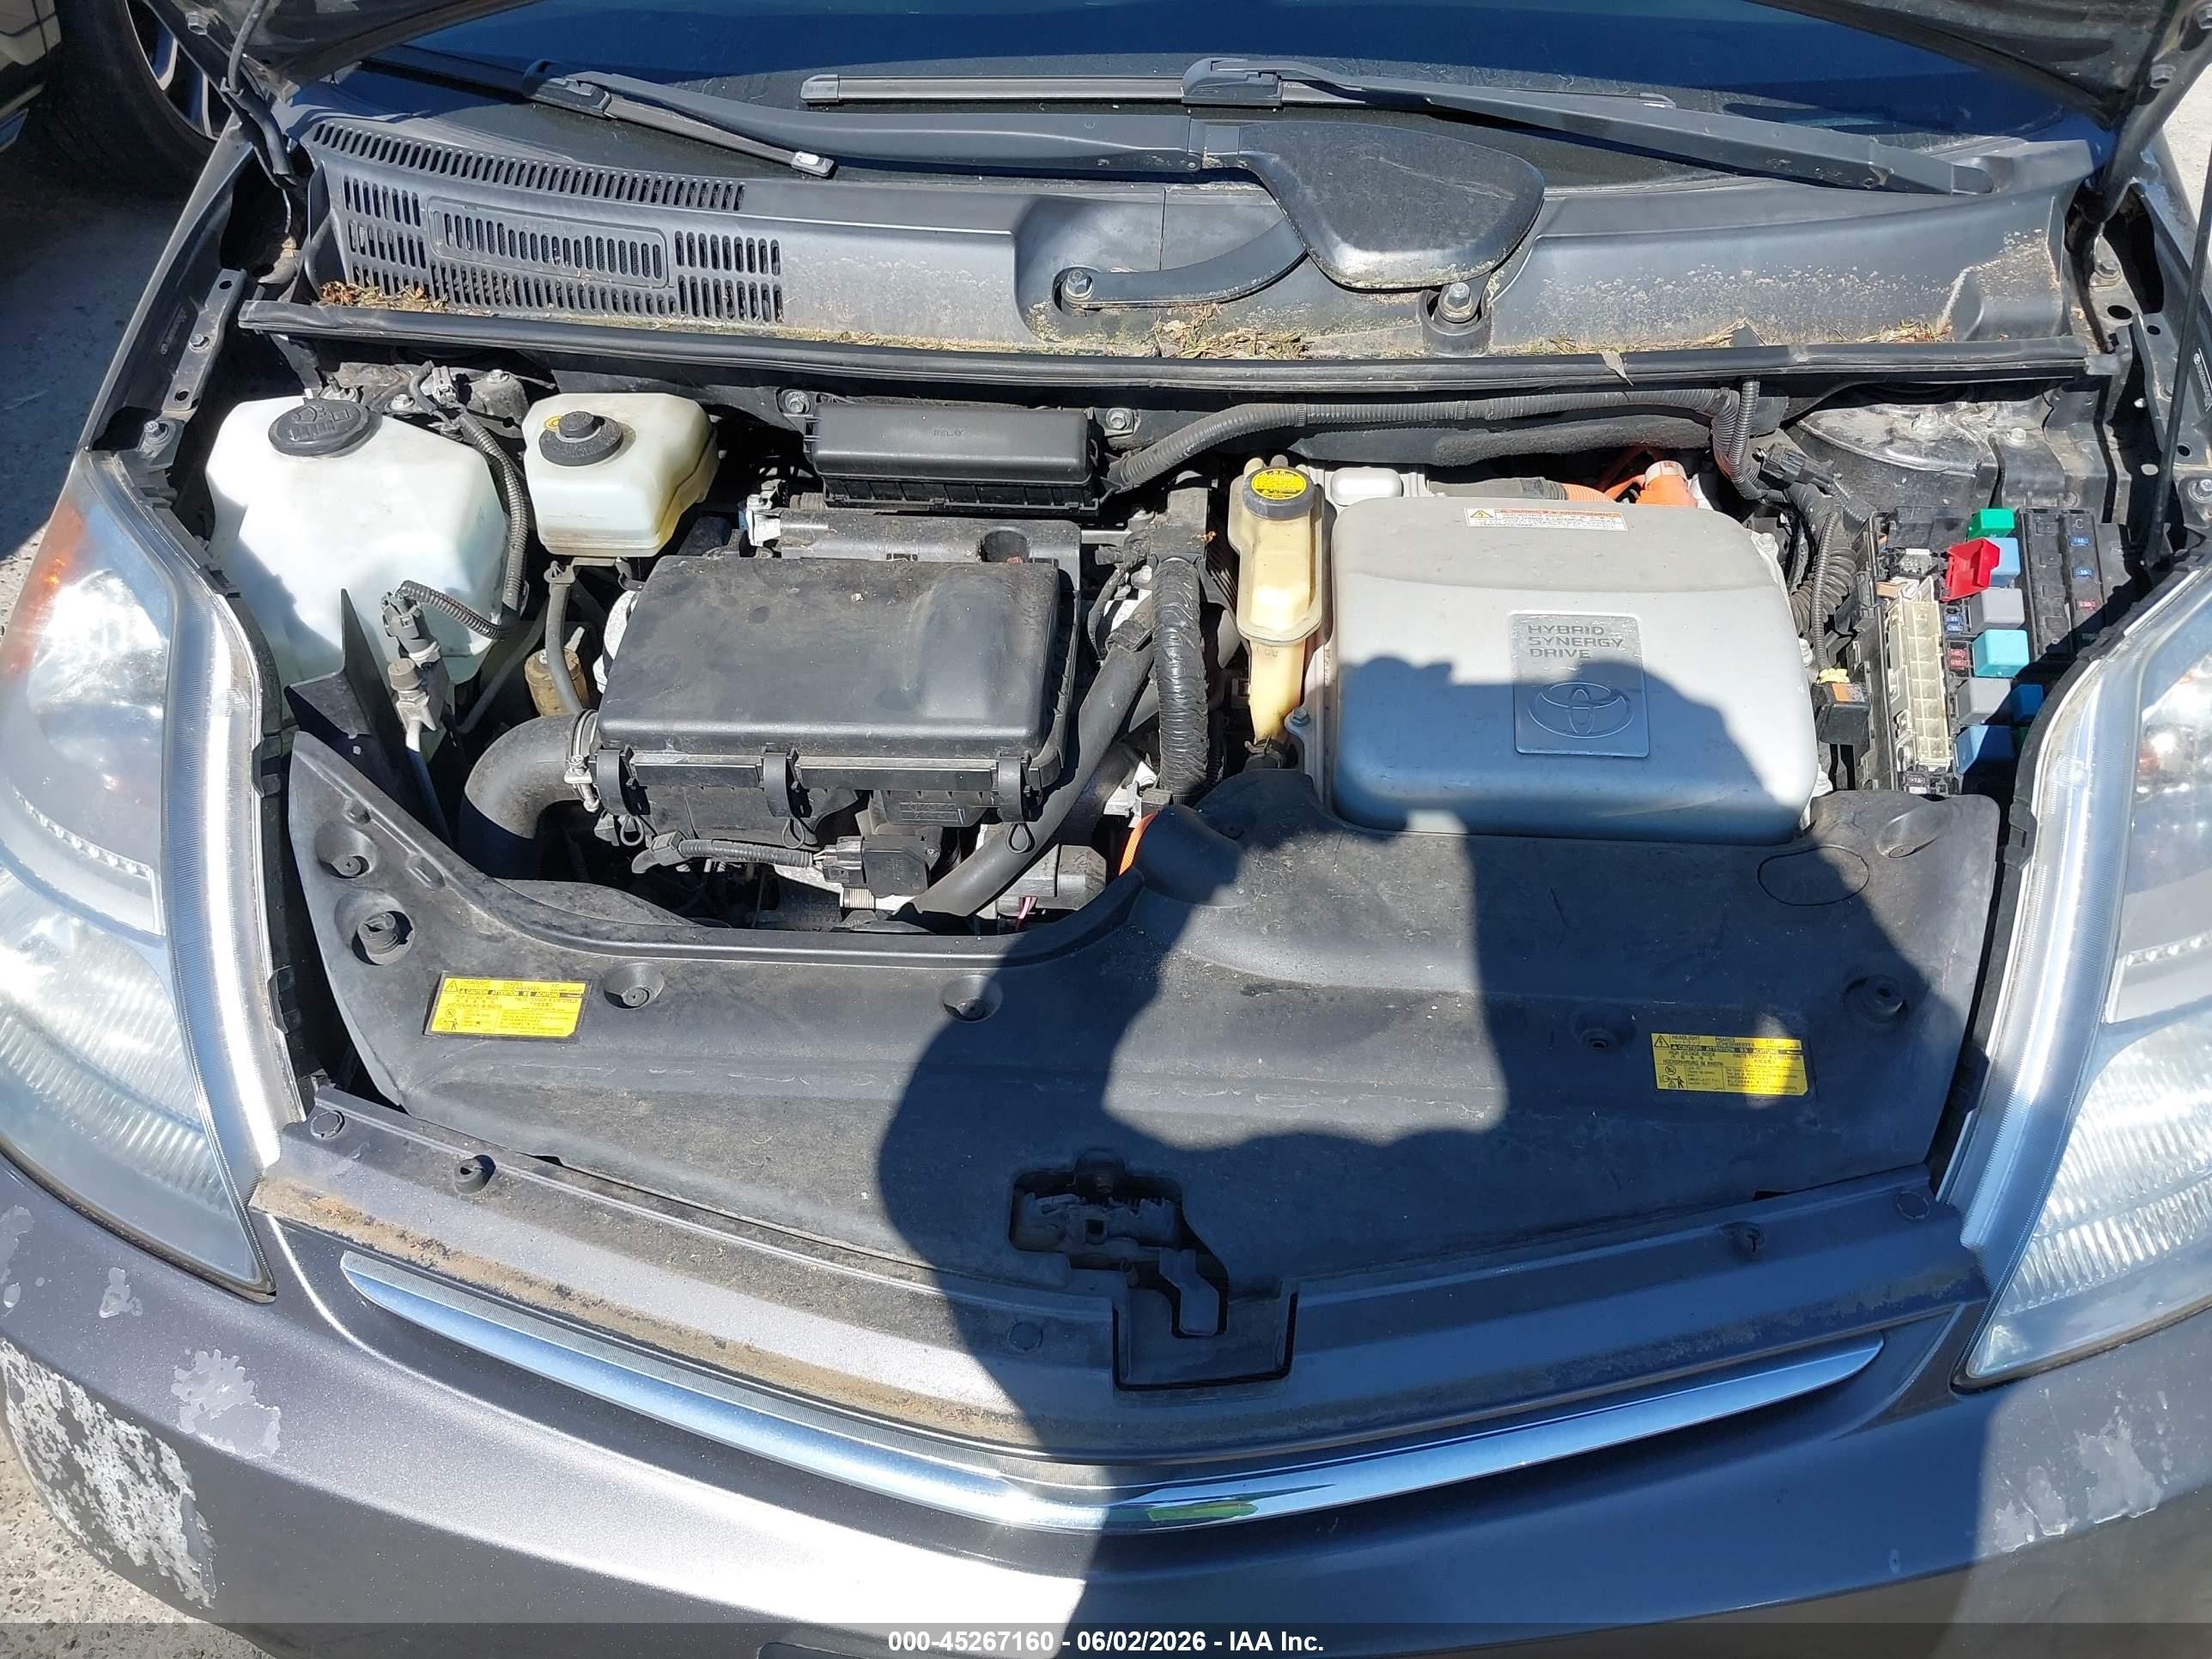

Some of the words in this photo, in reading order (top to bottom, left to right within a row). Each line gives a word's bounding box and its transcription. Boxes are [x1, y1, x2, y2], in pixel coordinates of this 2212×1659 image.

[933, 426, 969, 438] RELAY
[2075, 518, 2083, 529] C
[1528, 624, 1604, 635] HYBRID
[1528, 636, 1624, 647] SYNERGY
[1529, 648, 1591, 659] DRIVE
